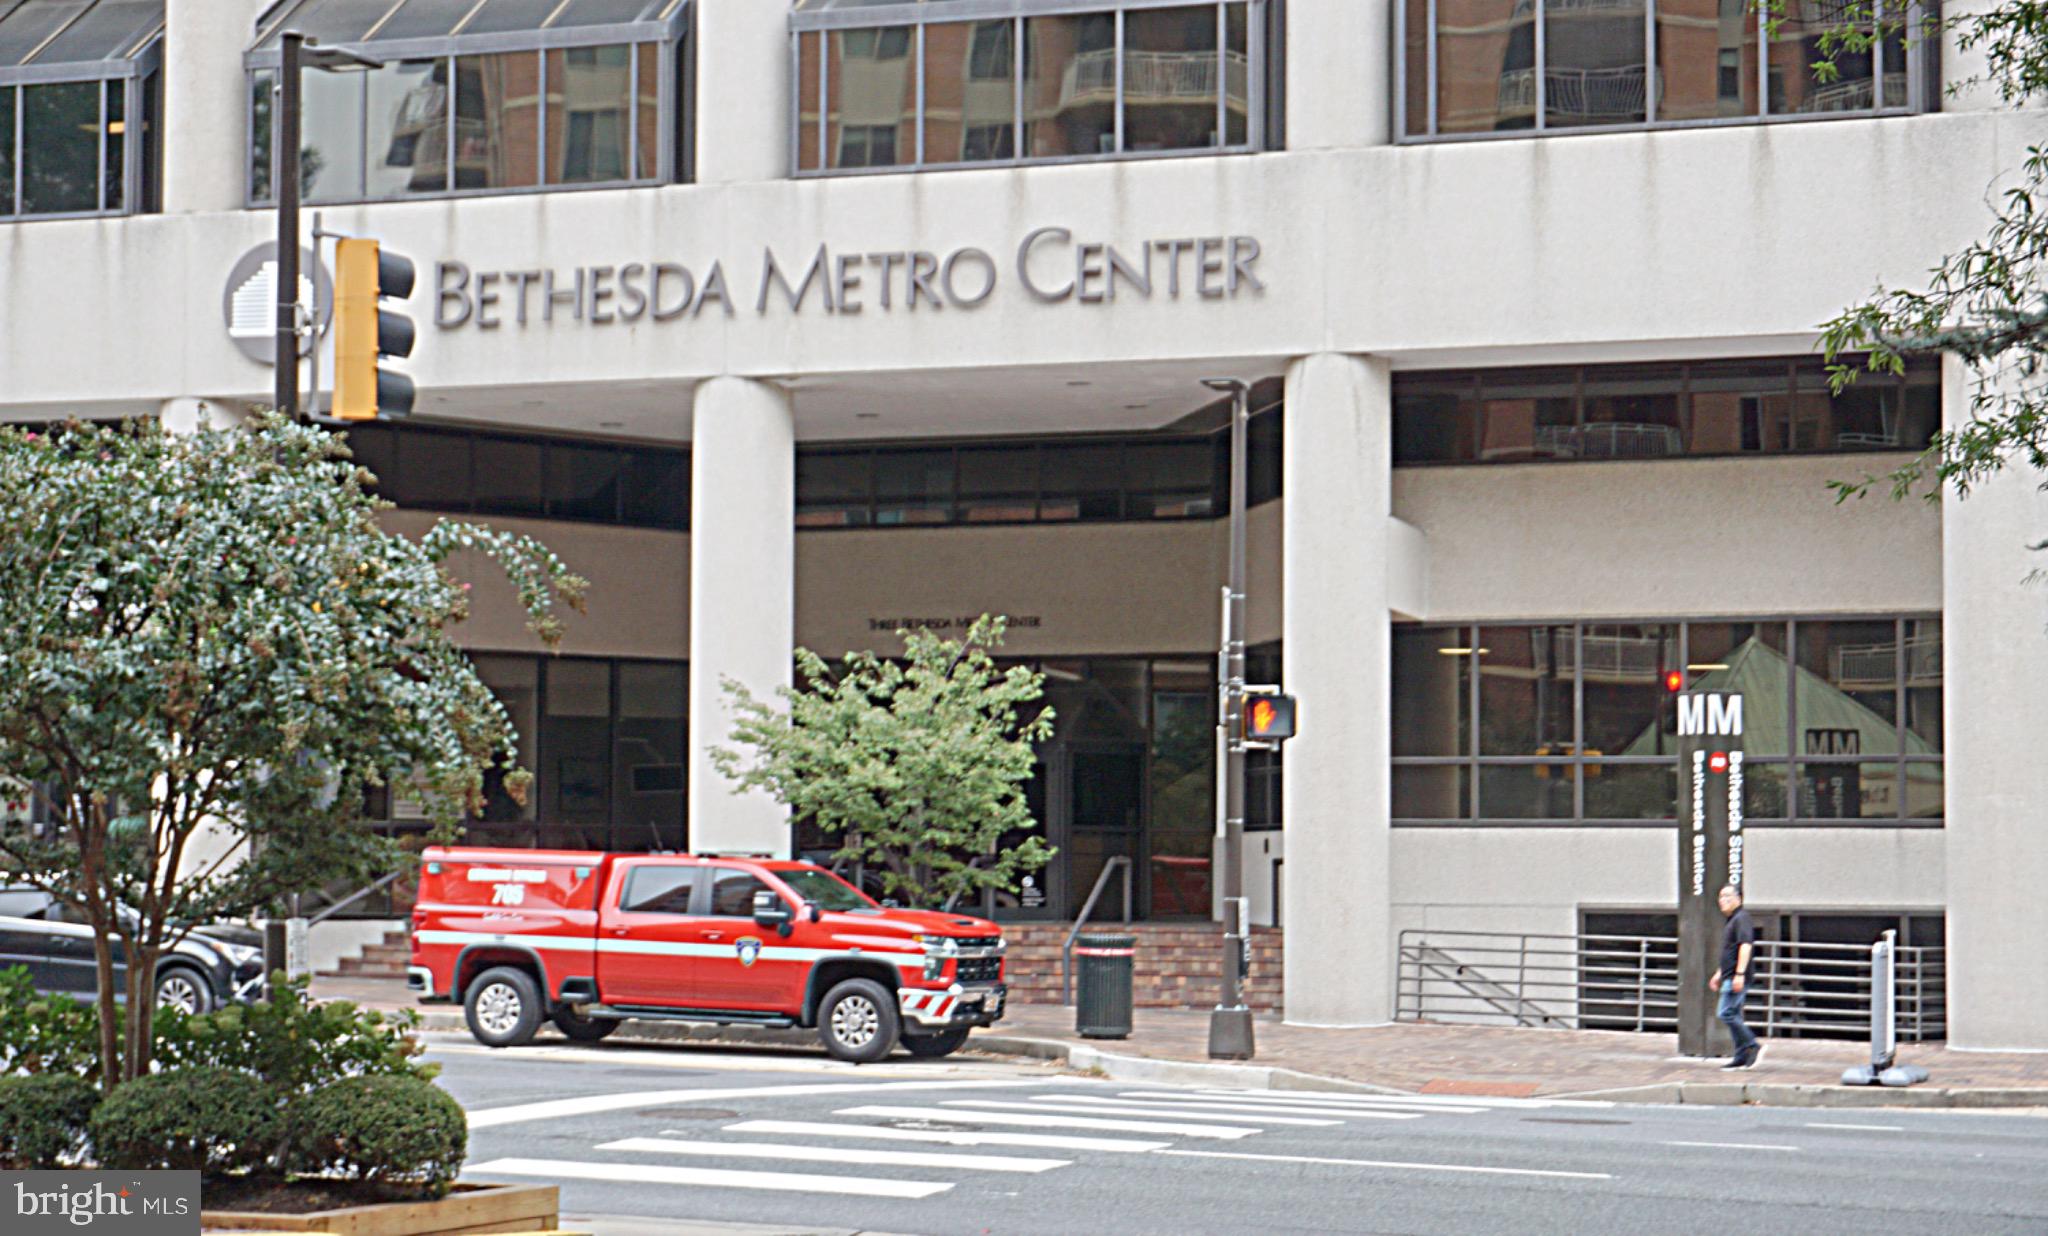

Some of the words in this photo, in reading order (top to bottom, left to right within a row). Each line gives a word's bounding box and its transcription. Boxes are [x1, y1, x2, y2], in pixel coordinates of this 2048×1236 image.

[433, 259, 735, 329] BETHESDA
[757, 242, 998, 314] METRO
[1016, 226, 1265, 303] CENTER
[1728, 750, 1743, 832] Bethesda
[1728, 835, 1743, 885] Statio
